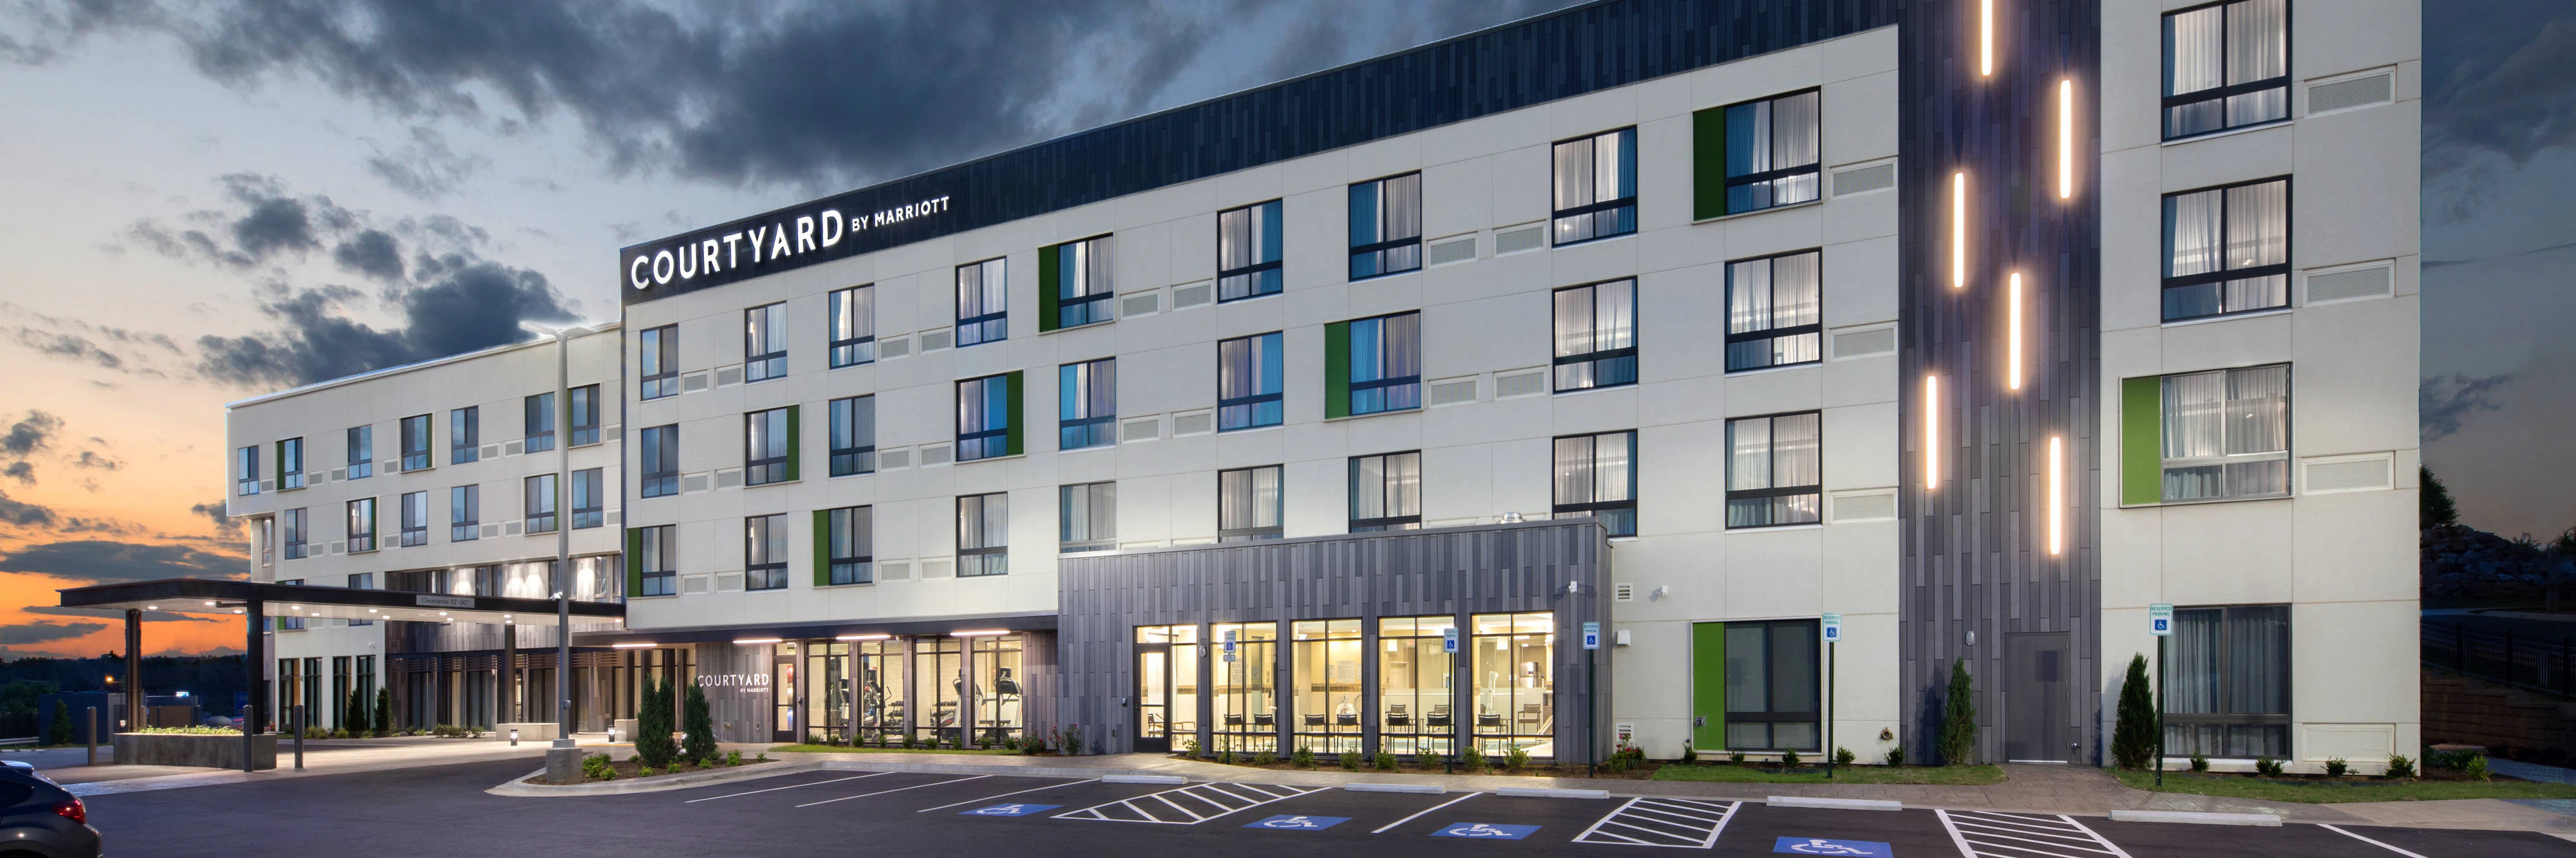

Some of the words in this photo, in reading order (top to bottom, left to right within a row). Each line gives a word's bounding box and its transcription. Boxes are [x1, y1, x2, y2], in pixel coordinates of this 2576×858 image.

[630, 209, 844, 290] COURTYARD
[852, 215, 869, 232] BY
[875, 196, 949, 227] MARRIOTT
[698, 673, 769, 687] COURTYARD
